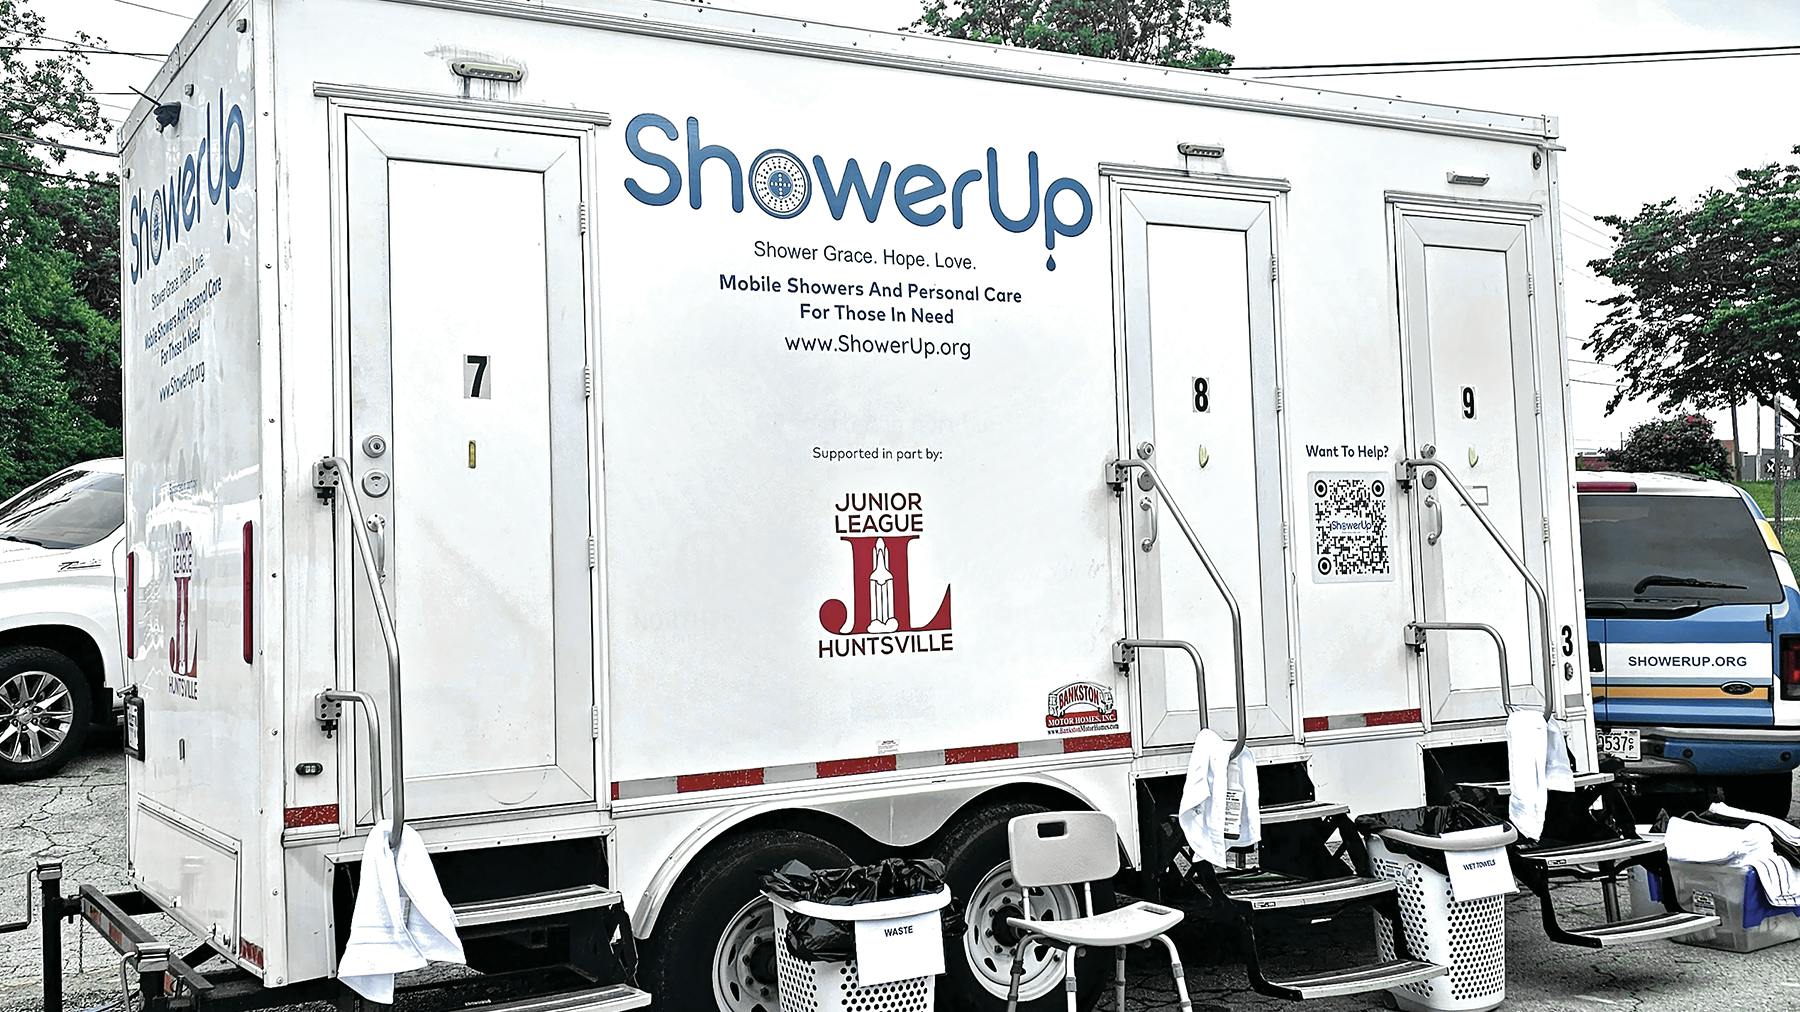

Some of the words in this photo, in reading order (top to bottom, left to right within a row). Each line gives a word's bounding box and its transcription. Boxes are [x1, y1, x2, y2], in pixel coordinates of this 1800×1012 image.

[130, 87, 245, 285] ShowerUp
[624, 112, 1093, 251] ShowerUp
[753, 240, 819, 262] Shower
[823, 244, 878, 266] Grace.
[883, 249, 930, 270] Hope.
[935, 252, 977, 270] Love.
[208, 277, 221, 298] Care
[719, 274, 782, 294] Mobile
[786, 277, 864, 298] Showers
[869, 280, 903, 298] And
[907, 283, 980, 302] Personal
[984, 286, 1022, 303] Care
[800, 303, 832, 321] For
[837, 305, 887, 323] Those
[891, 307, 906, 323] In
[911, 308, 955, 324] Need
[784, 334, 972, 361] www.ShowerUp.org
[466, 355, 488, 398] 7
[1194, 377, 1209, 412] 8
[1462, 386, 1475, 419] 9
[812, 446, 879, 462] Supported
[882, 448, 893, 460] in
[896, 449, 923, 462] part
[926, 448, 944, 463] by:
[1305, 444, 1339, 458] Want
[1341, 445, 1355, 458] To
[1357, 445, 1389, 461] Help?
[835, 492, 923, 512] JUNIOR
[835, 513, 924, 534] LEAGUE
[1331, 520, 1373, 532] ShowerUp
[173, 531, 193, 552] JUNIOR
[173, 553, 193, 574] LEAGUE
[818, 633, 954, 659] HUNTSVILLE
[1561, 624, 1573, 657] 3
[1628, 656, 1748, 667] SHOWERUP.ORG
[168, 675, 198, 700] HUNTSVILLE
[1058, 684, 1100, 709] BANKSTON
[1047, 717, 1074, 727] MOTOR
[1102, 713, 1117, 722] INC.
[1462, 862, 1476, 871] WET
[884, 925, 914, 938] WASTE
